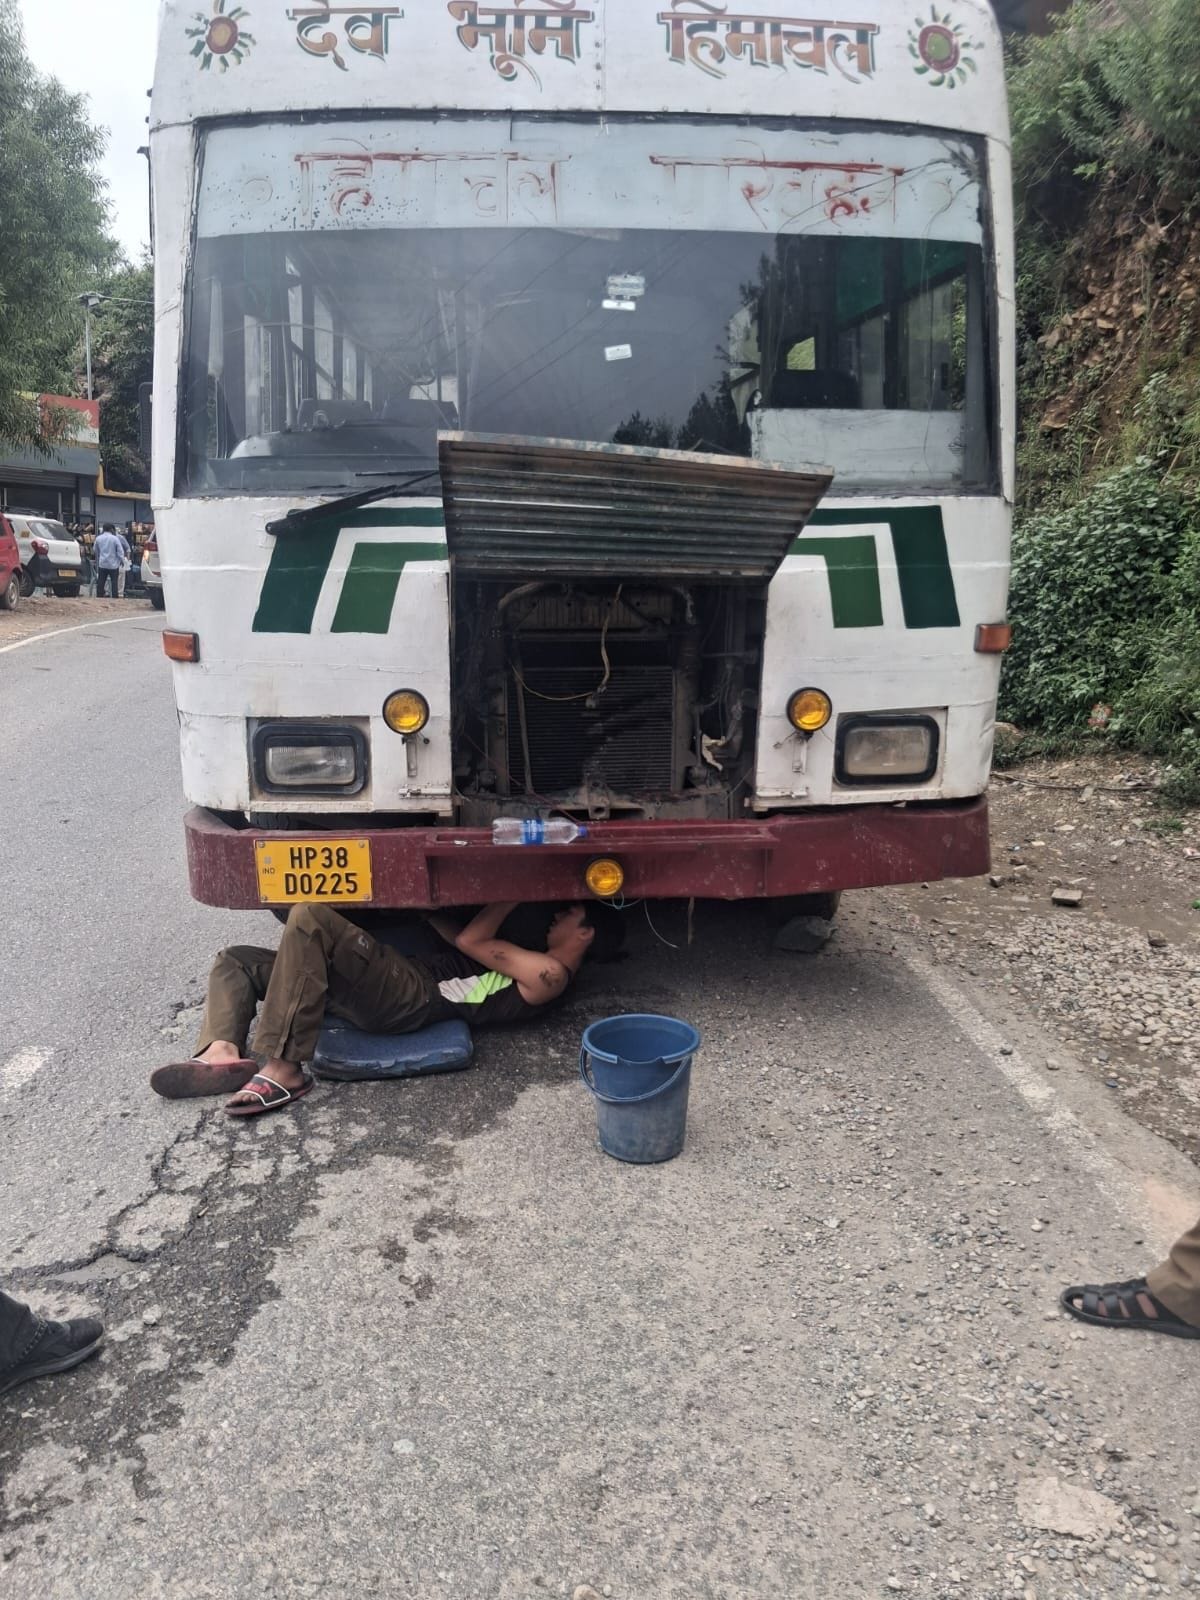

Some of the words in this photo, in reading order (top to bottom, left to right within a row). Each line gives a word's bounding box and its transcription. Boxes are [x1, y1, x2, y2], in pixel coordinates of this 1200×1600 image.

[286, 0, 404, 71] देव
[447, 0, 595, 92] भूमि
[656, 0, 880, 84] हिमाचल
[289, 846, 348, 869] HP38
[262, 867, 275, 875] IND
[284, 873, 358, 895] D0225
